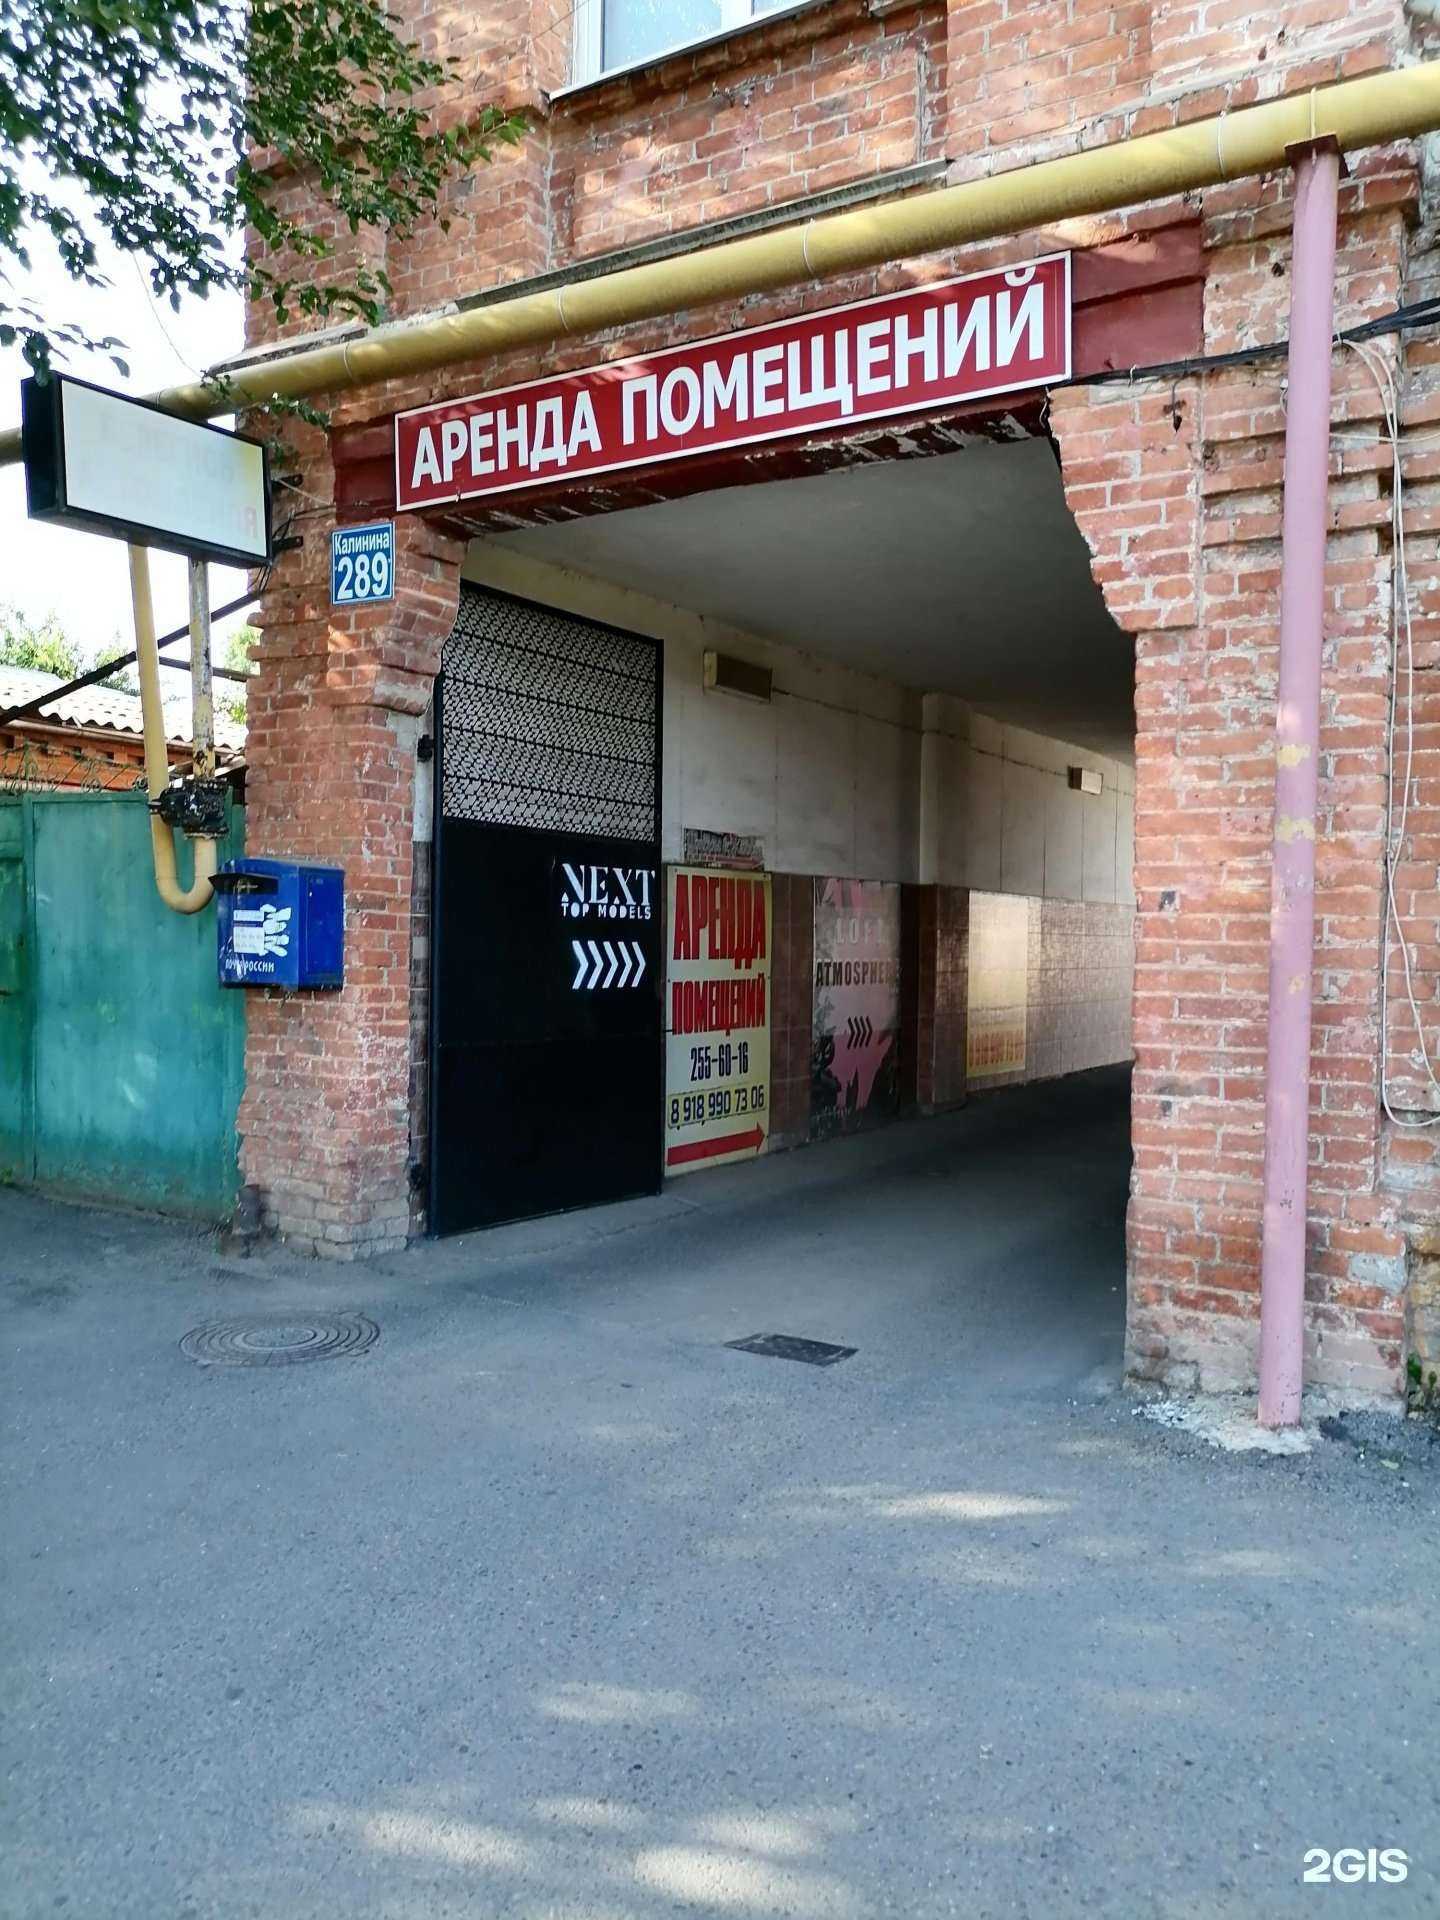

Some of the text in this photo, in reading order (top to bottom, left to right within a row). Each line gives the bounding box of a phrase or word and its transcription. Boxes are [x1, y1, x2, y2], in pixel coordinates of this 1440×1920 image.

[411, 390, 601, 488] АРЕНДА
[622, 265, 1046, 445] ПОМЕЩЕНИЙ
[335, 532, 390, 556] Калинина
[337, 551, 389, 600] 289
[561, 863, 656, 906] NEXT
[561, 902, 652, 920] TOP MODELS
[673, 874, 766, 969] АРЕНДА
[815, 957, 903, 988] ATMOSPHER
[672, 973, 766, 1036] ПОМЕЩЕНИЙ
[690, 1041, 749, 1082] 255-60-16
[671, 1084, 765, 1124] 8 918 990 73 06
